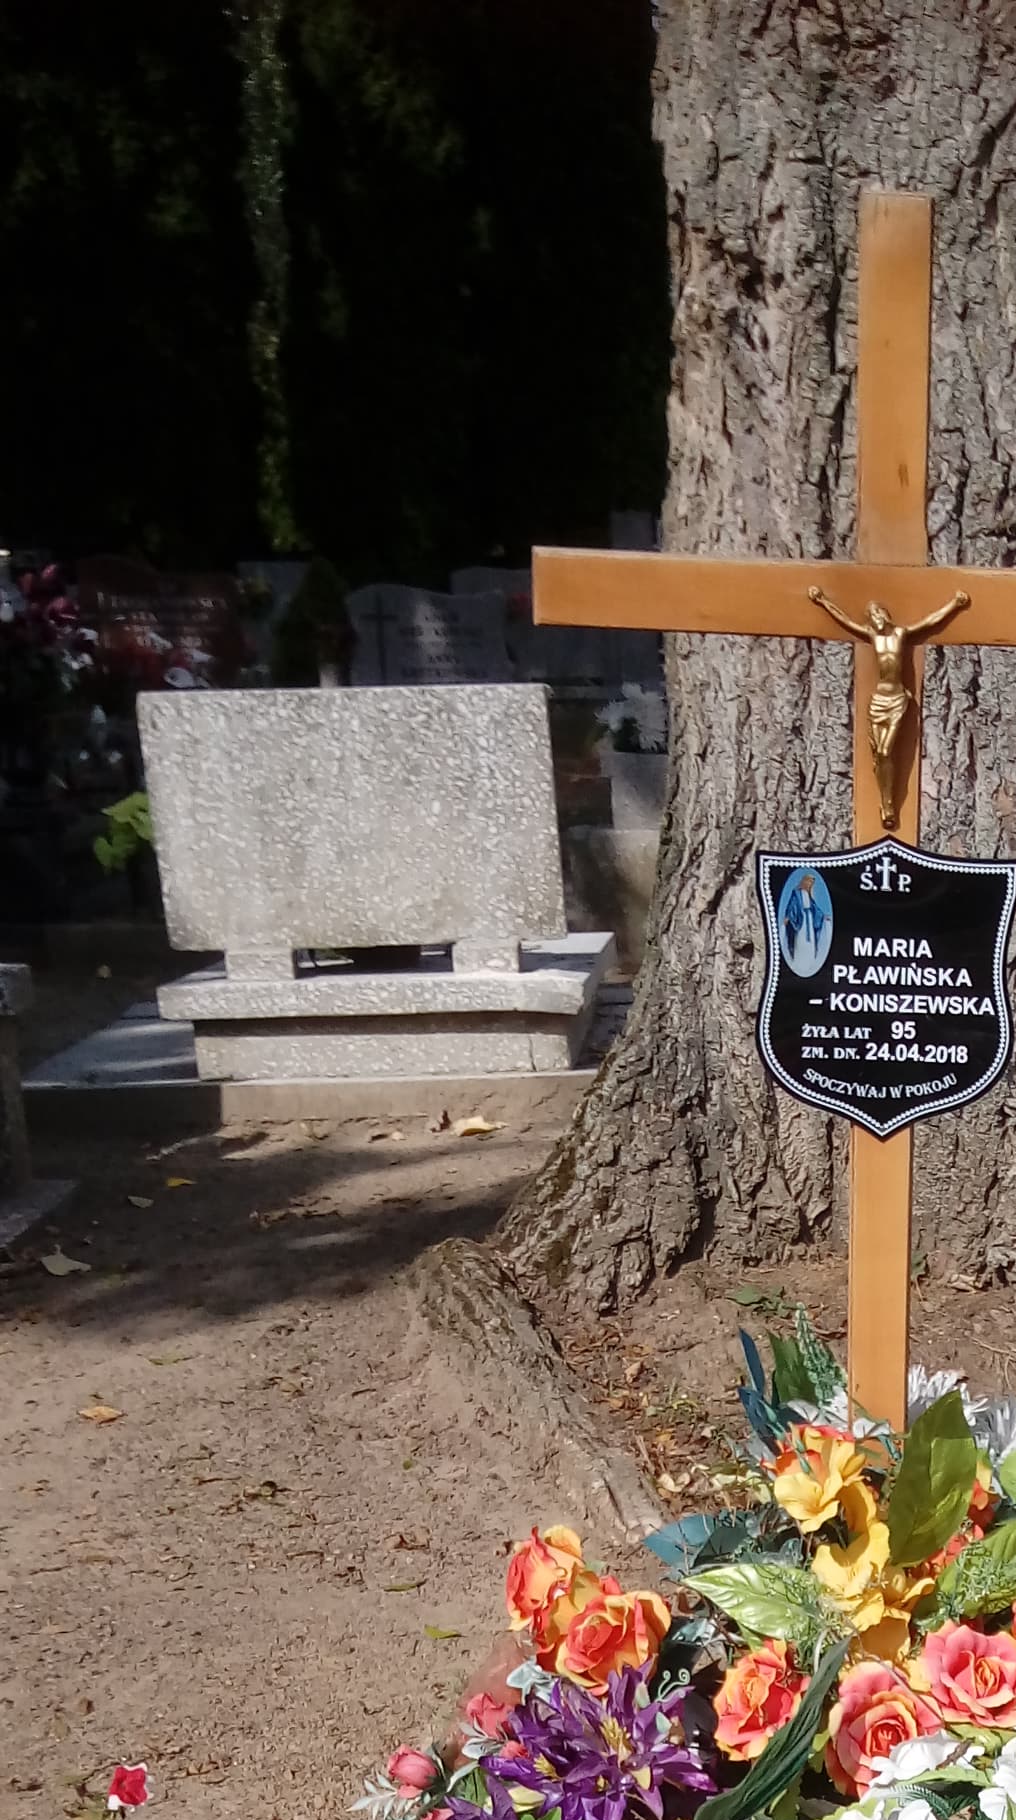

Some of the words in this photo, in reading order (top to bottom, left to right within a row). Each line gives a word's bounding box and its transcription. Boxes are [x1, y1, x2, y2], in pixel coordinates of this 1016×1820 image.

[853, 937, 933, 959] MARIA
[833, 962, 973, 987] PŁAWIŃSKA
[830, 993, 995, 1016] KONISZEWSKA
[801, 1023, 840, 1039] ŻYŁA
[844, 1027, 872, 1040] LAT
[891, 1021, 917, 1040] 95
[801, 1046, 829, 1059] ZM.
[833, 1047, 861, 1060] DN.
[865, 1043, 969, 1064] 24.04.2018
[803, 1068, 887, 1098] SPOCZYWAJ
[890, 1086, 902, 1098] W
[905, 1073, 958, 1097] POKOJU
